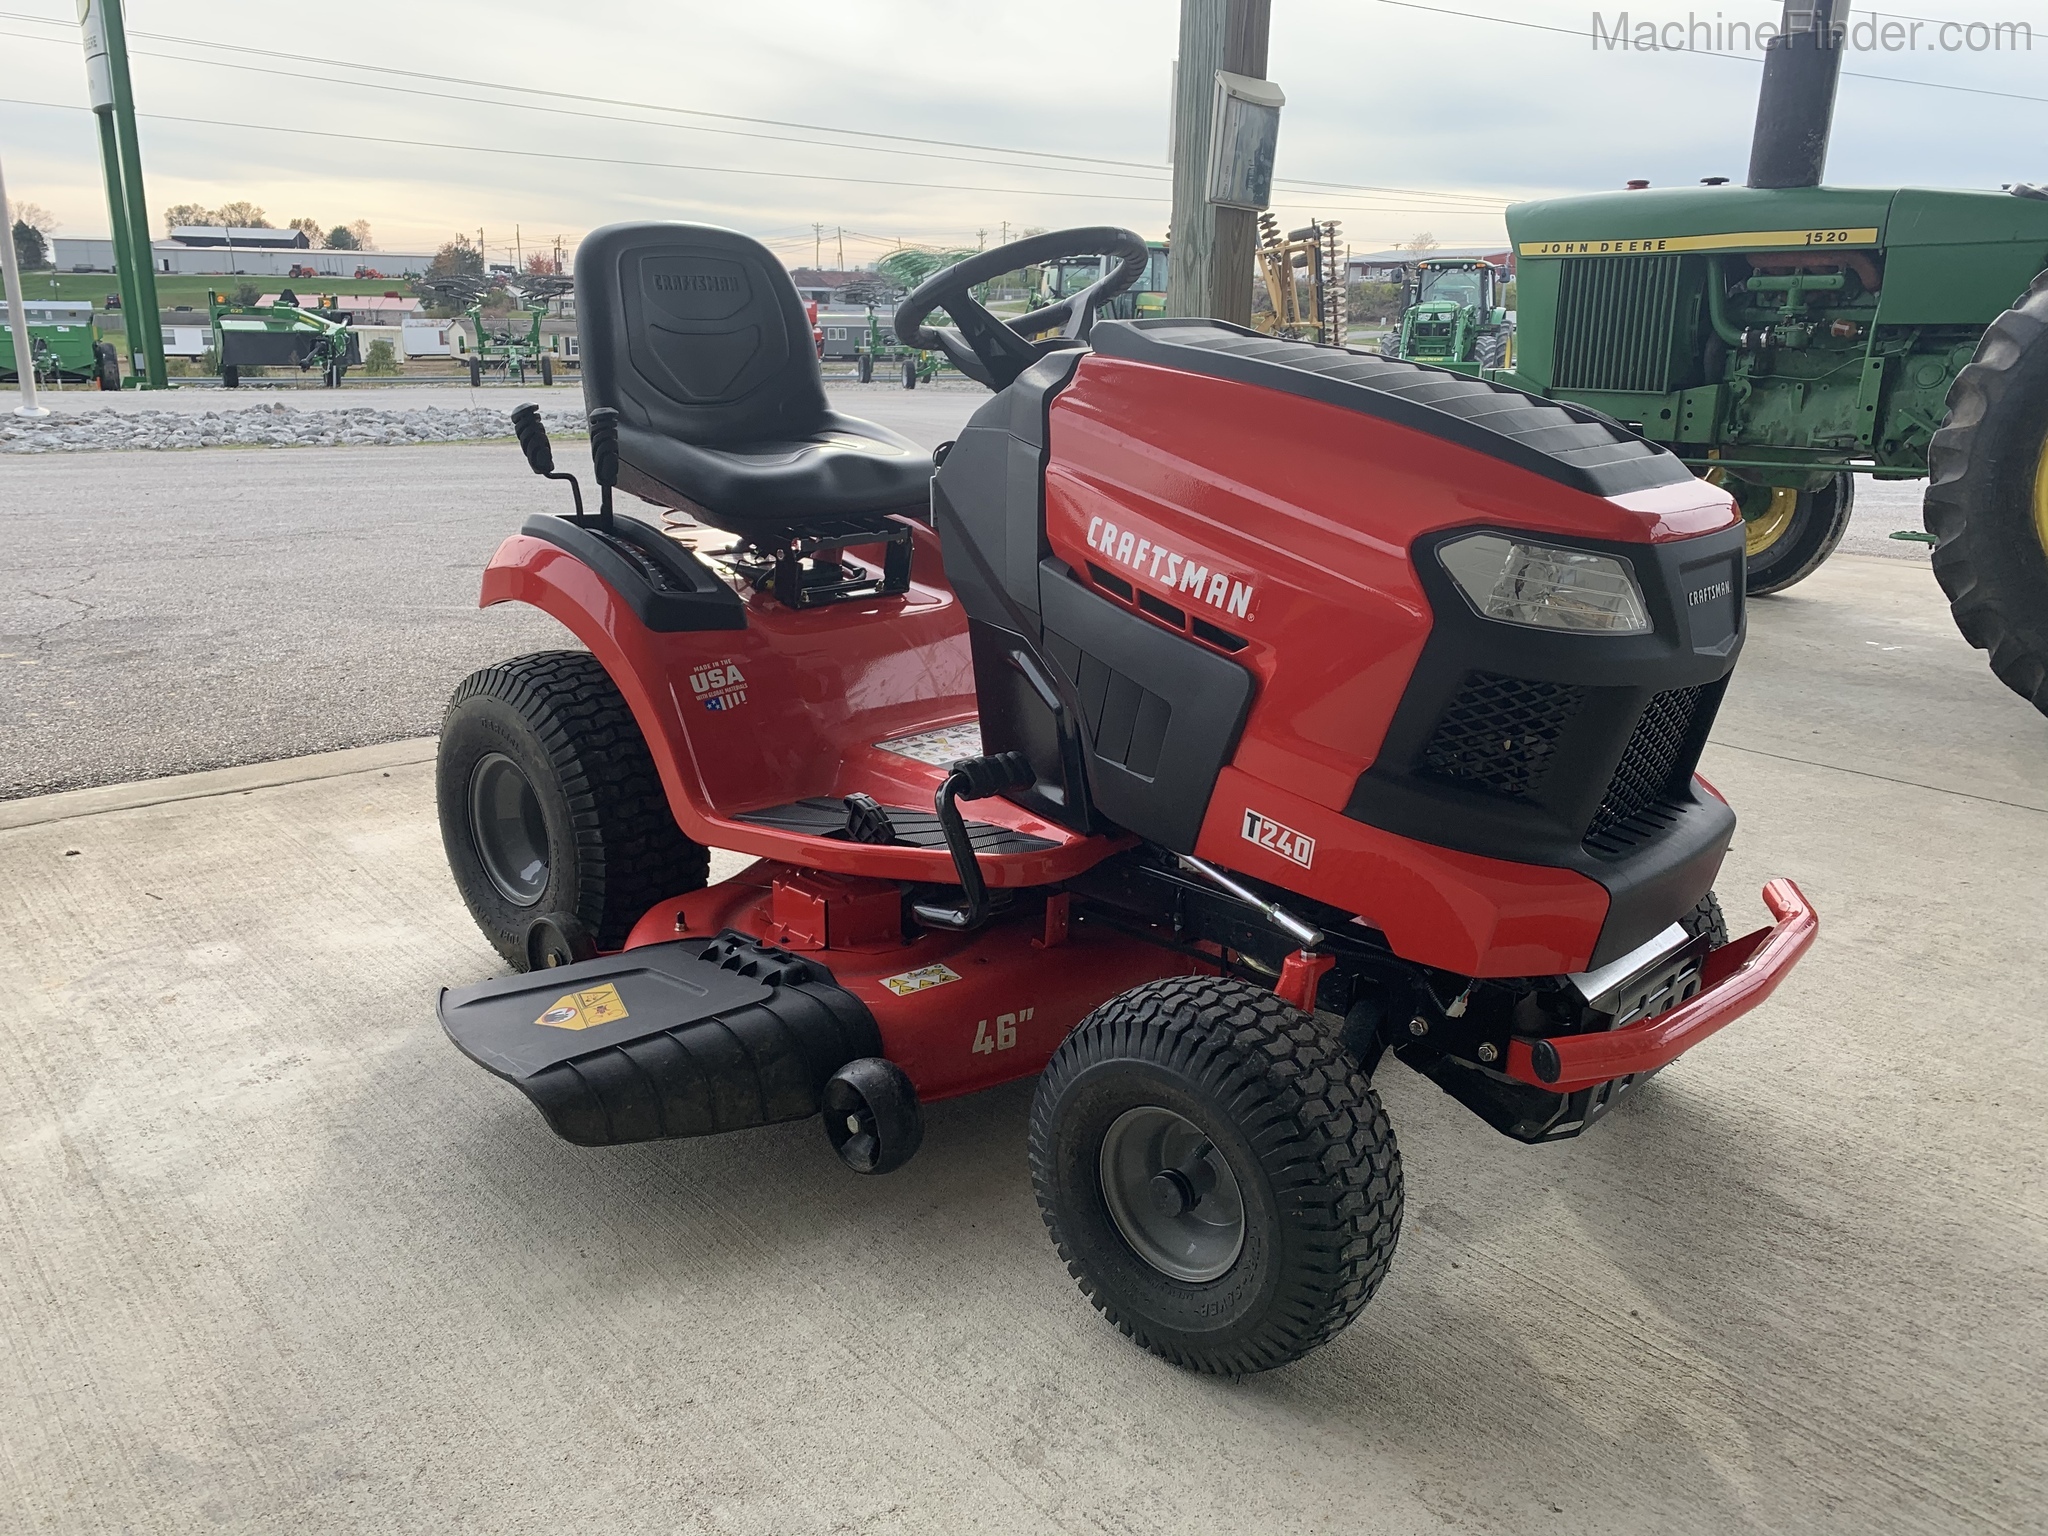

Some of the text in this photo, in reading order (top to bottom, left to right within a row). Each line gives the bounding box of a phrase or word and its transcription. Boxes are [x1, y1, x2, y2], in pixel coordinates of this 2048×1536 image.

[1541, 240, 1667, 254] JOHN DEERE
[1804, 231, 1849, 246] 1520
[653, 274, 740, 291] CRAFTSMAN
[1086, 515, 1254, 619] CRAFTSMAN
[1688, 580, 1730, 607] CRAFTSMAN
[689, 664, 745, 693] USA
[693, 663, 711, 673] MADE
[720, 658, 732, 666] THE
[1245, 810, 1311, 864] T240
[972, 1007, 1034, 1055] 46"
